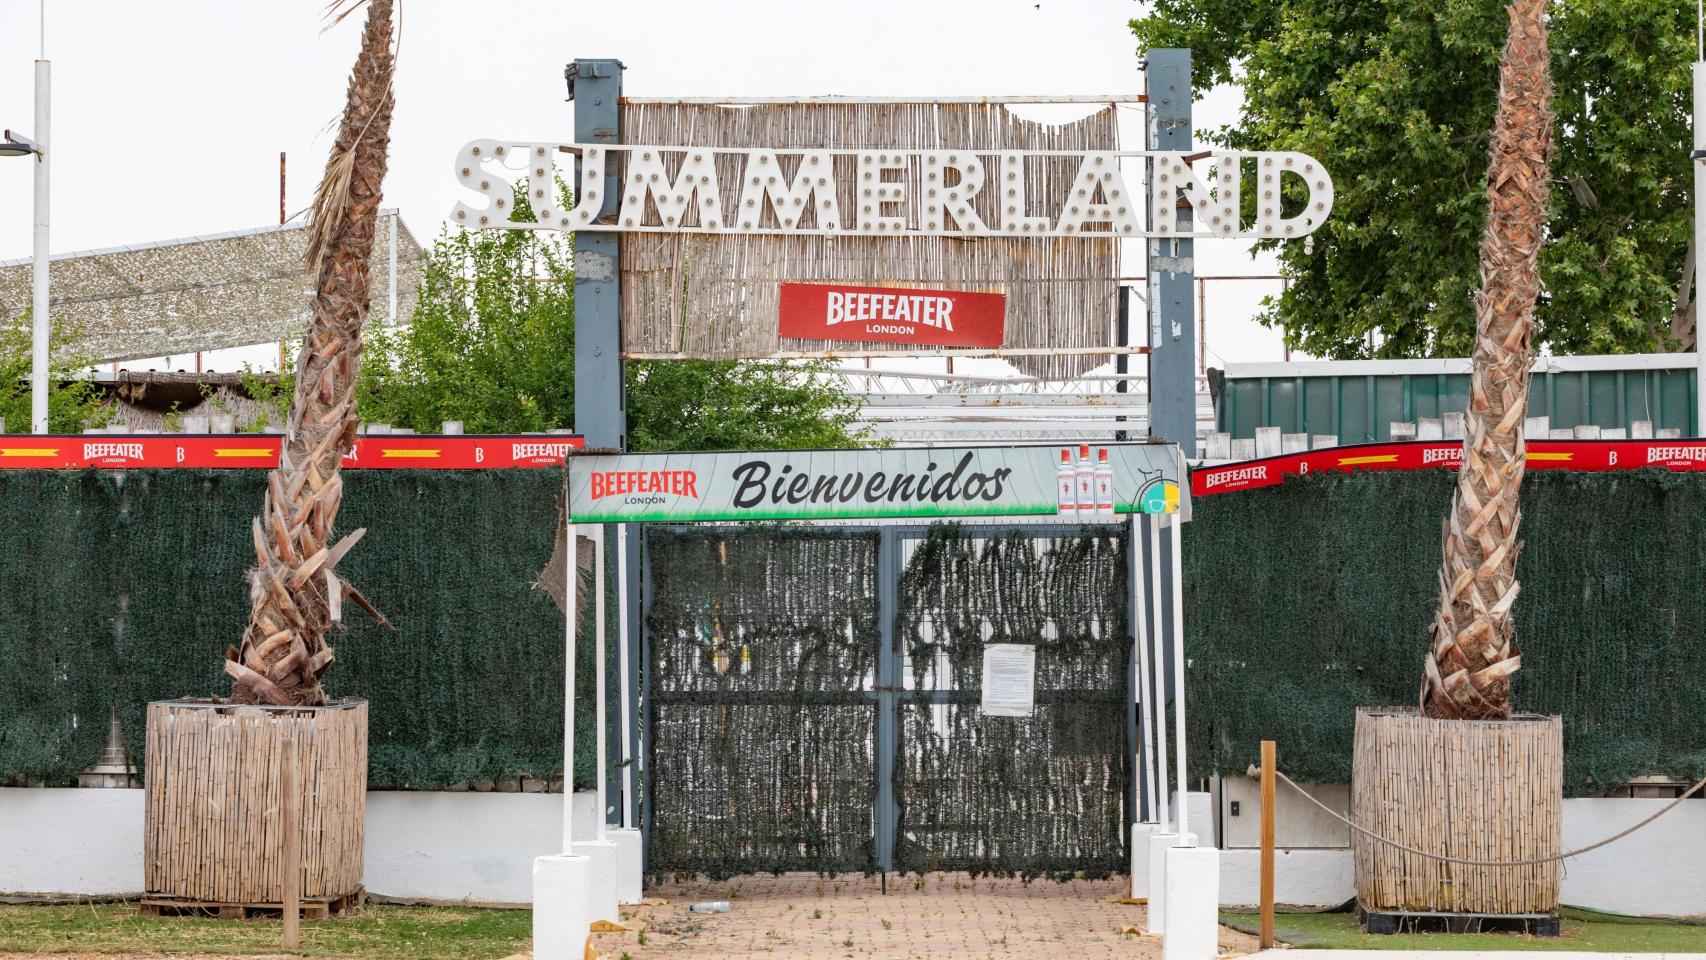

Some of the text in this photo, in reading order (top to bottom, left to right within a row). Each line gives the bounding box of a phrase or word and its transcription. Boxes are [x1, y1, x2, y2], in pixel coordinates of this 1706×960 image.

[450, 139, 1334, 238] SUMMERLAND
[826, 291, 954, 332] BEEFEATER
[865, 323, 915, 335] LONDON
[83, 443, 144, 461] BEEFEATER
[176, 447, 185, 463] B
[475, 447, 484, 463] B
[1423, 448, 1464, 464] BEEFEA
[1609, 451, 1618, 466] B
[1300, 462, 1308, 475] B
[732, 451, 1013, 509] Bienvenidos
[1206, 465, 1267, 489] BEEFEATER
[1225, 480, 1249, 488] LONDON
[590, 470, 698, 501] BEEFEATER
[624, 496, 666, 505] LONDON
